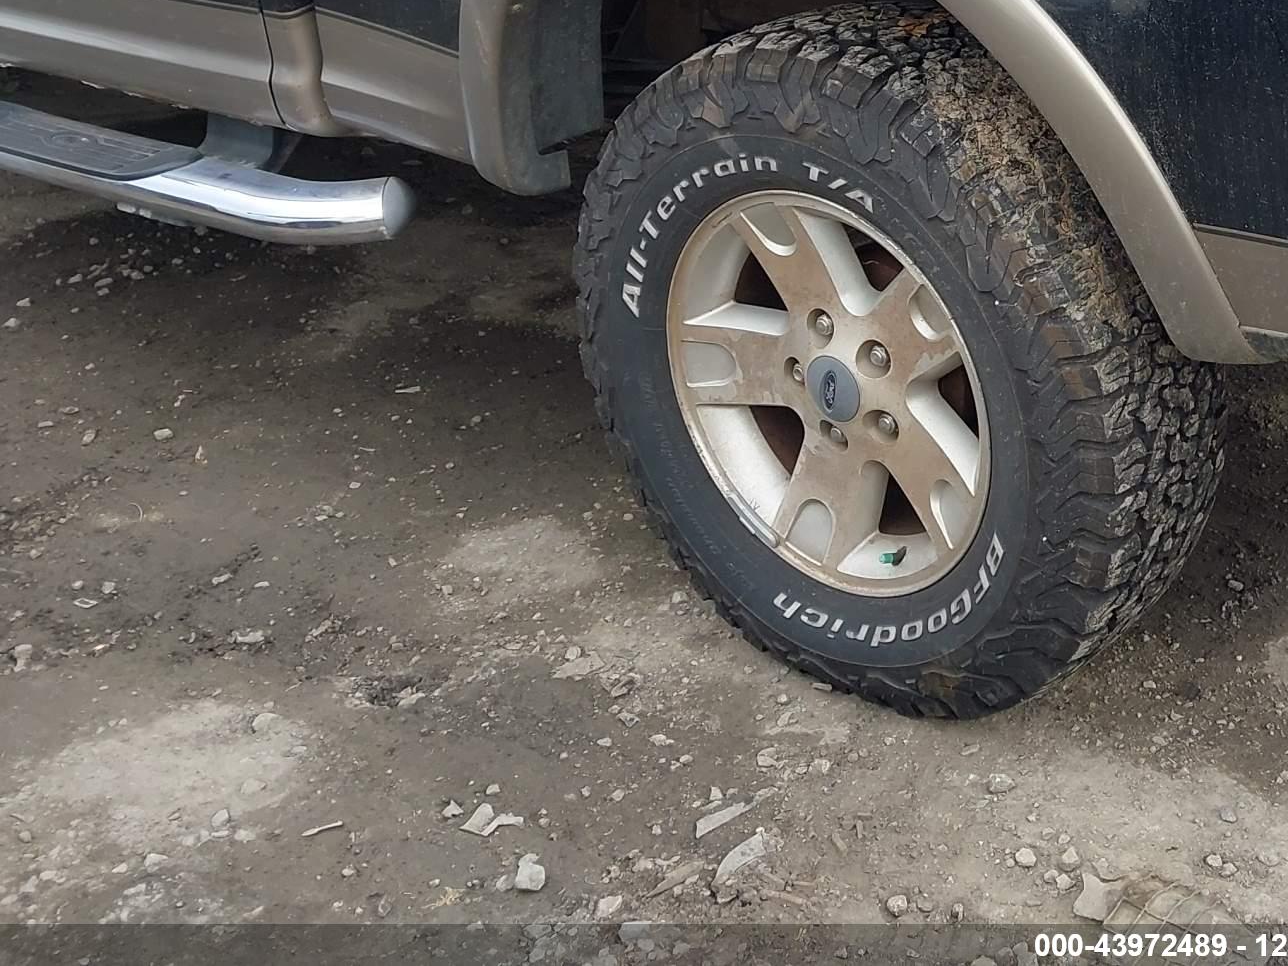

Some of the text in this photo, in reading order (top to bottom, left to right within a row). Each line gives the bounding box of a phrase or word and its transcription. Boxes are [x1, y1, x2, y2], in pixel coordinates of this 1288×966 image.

[622, 153, 875, 318] All-Terrain T/A
[772, 530, 1006, 647] BFGoodrich
